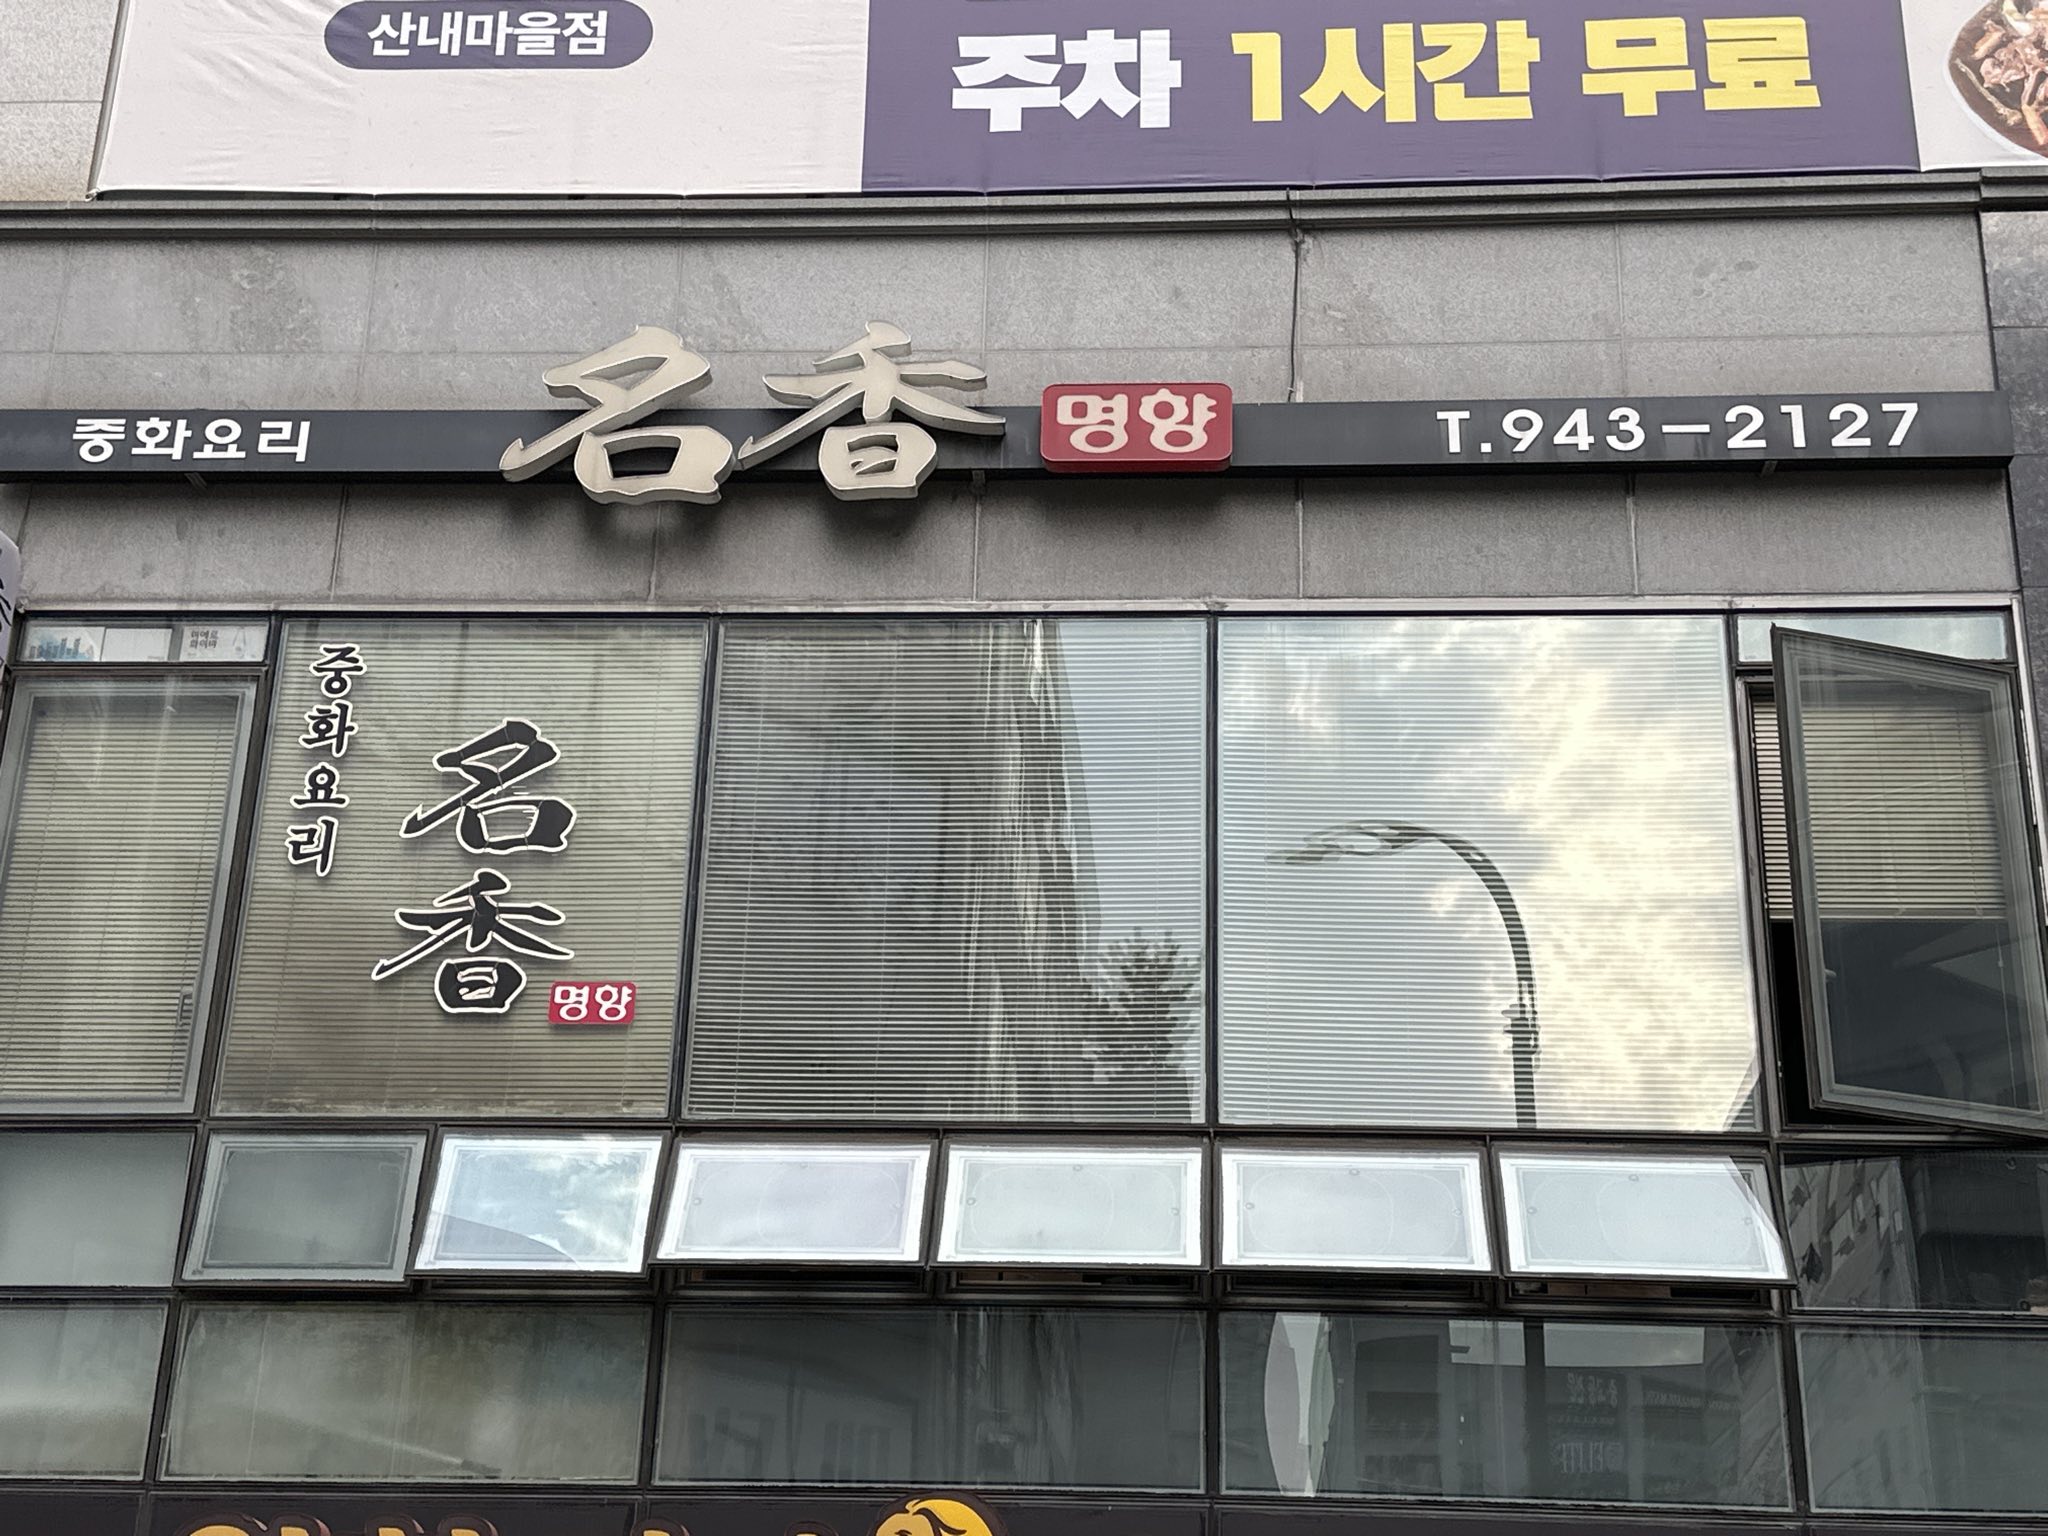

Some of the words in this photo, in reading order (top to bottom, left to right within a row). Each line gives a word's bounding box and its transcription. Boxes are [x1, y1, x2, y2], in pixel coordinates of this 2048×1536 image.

[367, 9, 608, 58] 산내마을점
[951, 27, 1182, 133] 주차
[1232, 18, 1541, 124] 1시간
[1582, 14, 1821, 117] 무료
[71, 416, 312, 465] 중화요리
[500, 320, 1006, 504] 名香
[1057, 388, 1217, 453] 명향
[1436, 402, 1920, 456] T.943-2127
[285, 642, 367, 877] 중화요리
[371, 717, 577, 1015] 名香
[553, 984, 633, 1021] 명향
